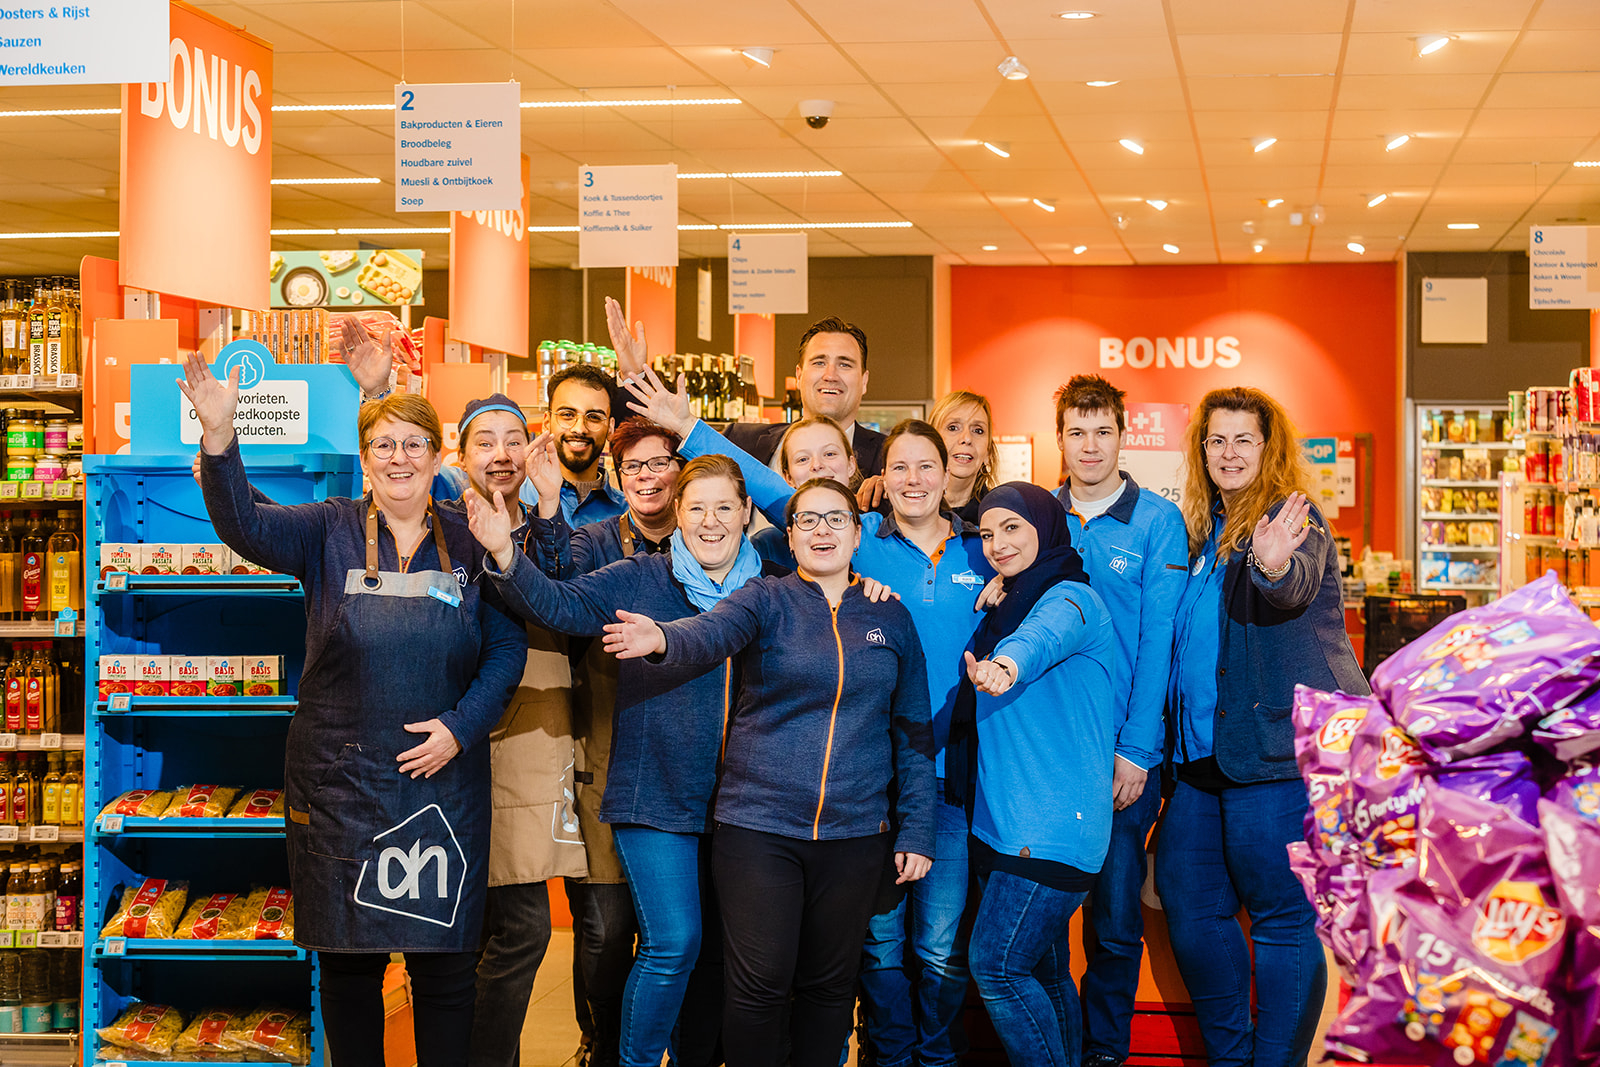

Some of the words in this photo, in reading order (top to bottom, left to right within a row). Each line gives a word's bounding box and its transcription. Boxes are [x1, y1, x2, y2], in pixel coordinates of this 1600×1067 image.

[48, 7, 58, 18] &
[62, 6, 90, 20] Rijst
[0, 62, 86, 76] Wereldkeuken
[401, 90, 414, 111] 2
[401, 120, 462, 130] Bakproducten
[465, 120, 472, 128] &
[475, 119, 503, 128] Eieren
[401, 139, 452, 149] Broodbeleg
[401, 158, 444, 167] Houdbare
[447, 158, 472, 166] zuivel
[401, 177, 430, 186] Muesli
[432, 177, 439, 186] &
[442, 176, 493, 187] Ontbijtkoek
[584, 171, 594, 187] 3
[401, 197, 424, 206] Soep
[1534, 231, 1543, 243] 8
[732, 239, 741, 250] 4
[1425, 282, 1432, 292] 9
[1100, 336, 1241, 369] BONUS
[238, 393, 288, 404] vorieten.
[233, 408, 300, 422] oedkoopste
[236, 424, 286, 436] oducten.
[1126, 434, 1165, 447] RATIS
[1416, 933, 1452, 966] 15
